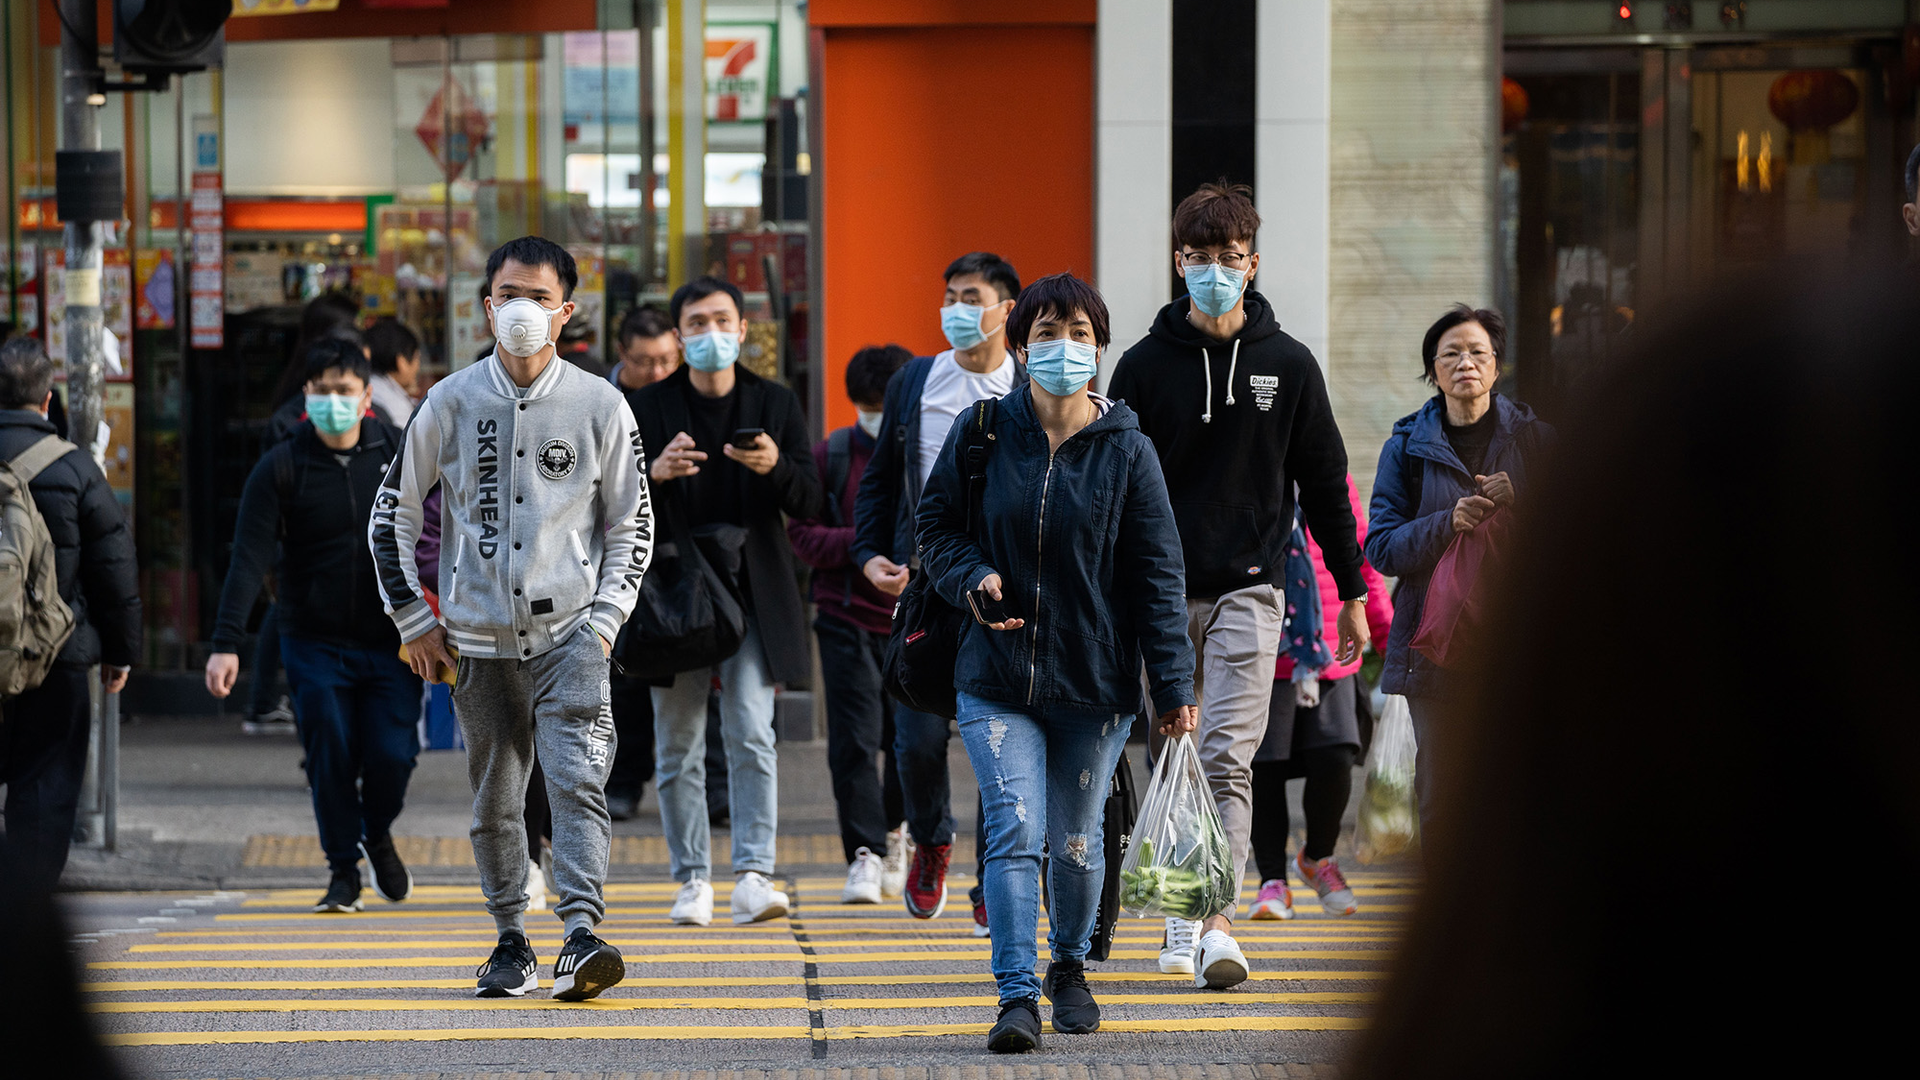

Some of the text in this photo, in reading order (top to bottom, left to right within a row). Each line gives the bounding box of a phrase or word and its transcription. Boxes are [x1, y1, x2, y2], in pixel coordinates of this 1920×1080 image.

[1252, 377, 1276, 385] Dickies
[477, 419, 498, 560] SKINHEAD
[621, 545, 649, 591] DIV.
[590, 704, 613, 767] RUNNER
